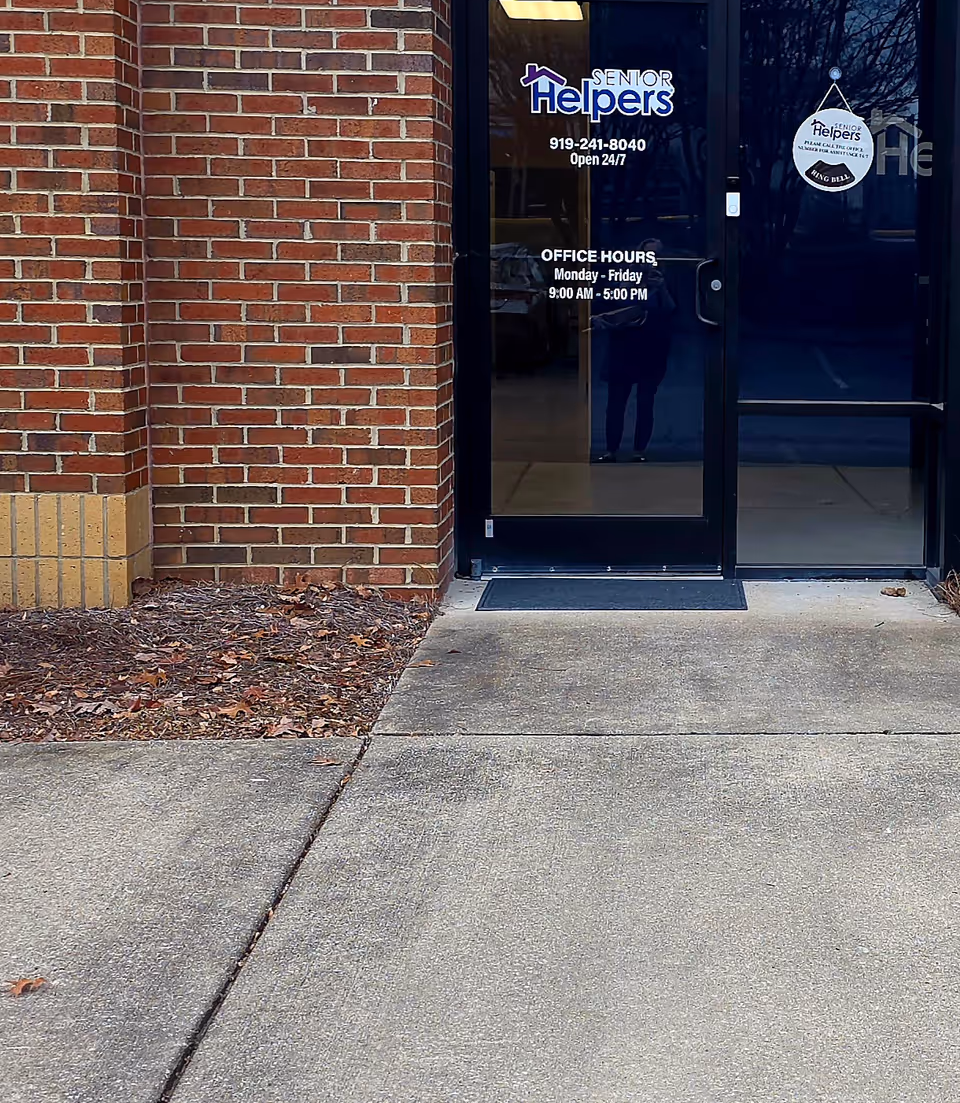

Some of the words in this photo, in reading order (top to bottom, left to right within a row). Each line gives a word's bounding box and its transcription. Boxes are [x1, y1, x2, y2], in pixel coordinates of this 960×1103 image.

[592, 69, 673, 87] SENIOR
[532, 79, 673, 121] Helpers
[813, 124, 861, 141] Helpers
[834, 122, 862, 132] SENIOR
[549, 137, 646, 151] 919-241-8040
[570, 152, 600, 168] Open
[601, 153, 627, 166] 24/7
[811, 169, 829, 183] RING
[831, 173, 850, 183] BELL
[541, 249, 598, 263] OFFICE
[600, 250, 656, 264] HOURS
[554, 268, 599, 283] Monday
[608, 269, 643, 284] Friday
[548, 286, 573, 299] 9:00
[575, 287, 594, 299] AM
[603, 288, 628, 300] 5:00
[630, 289, 648, 300] PM
